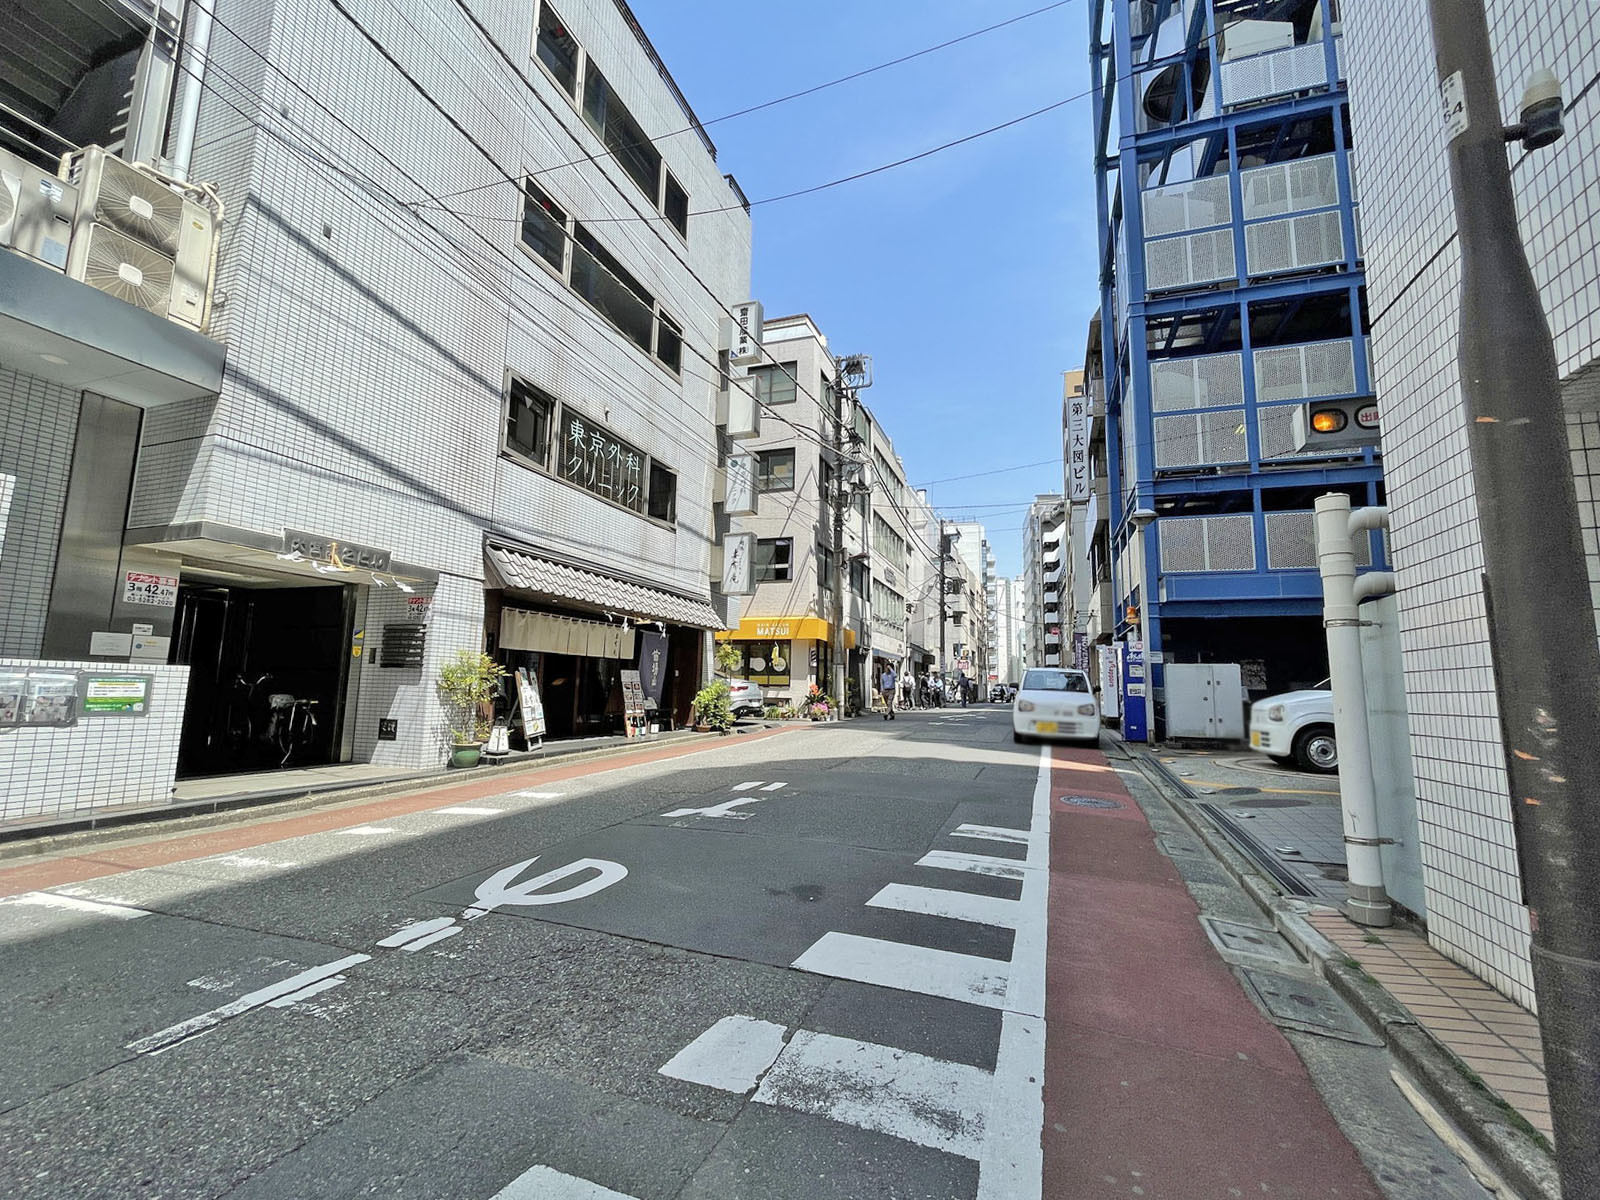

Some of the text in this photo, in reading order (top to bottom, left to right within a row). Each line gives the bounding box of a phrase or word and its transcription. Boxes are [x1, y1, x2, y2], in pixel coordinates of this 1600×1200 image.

[568, 419, 641, 479] 東京外科
[1071, 402, 1086, 496] 第三大図ビル
[568, 456, 640, 504] クリニック
[757, 627, 789, 636] MATSUI
